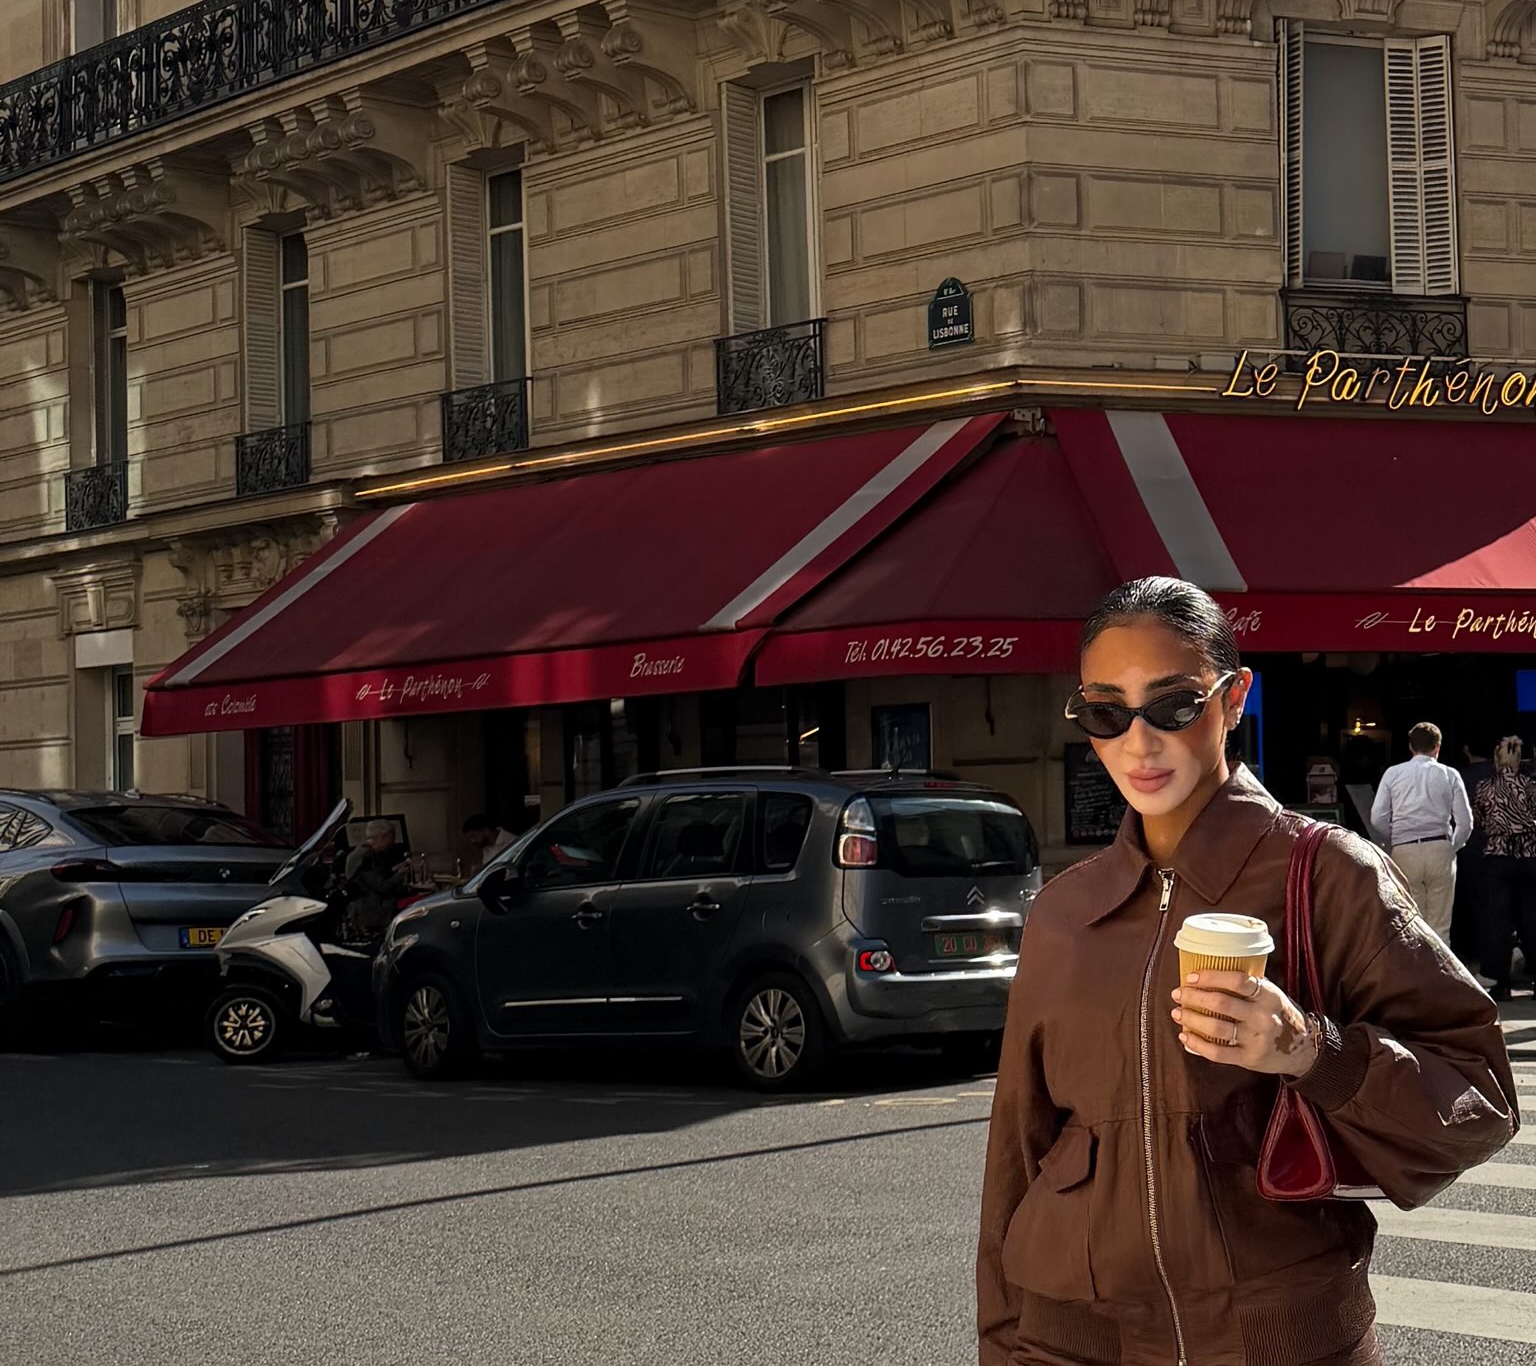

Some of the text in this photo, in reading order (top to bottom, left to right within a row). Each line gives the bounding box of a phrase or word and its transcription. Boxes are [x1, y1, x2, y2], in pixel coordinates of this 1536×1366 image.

[942, 305, 959, 318] RUE
[932, 323, 969, 340] LISBONNE
[1222, 349, 1279, 397] Le
[1408, 607, 1437, 634] Le
[845, 636, 1019, 664] Tél: 01.42.56.23.25
[629, 653, 686, 678] Brasserie
[379, 675, 463, 704] Le Parthénon
